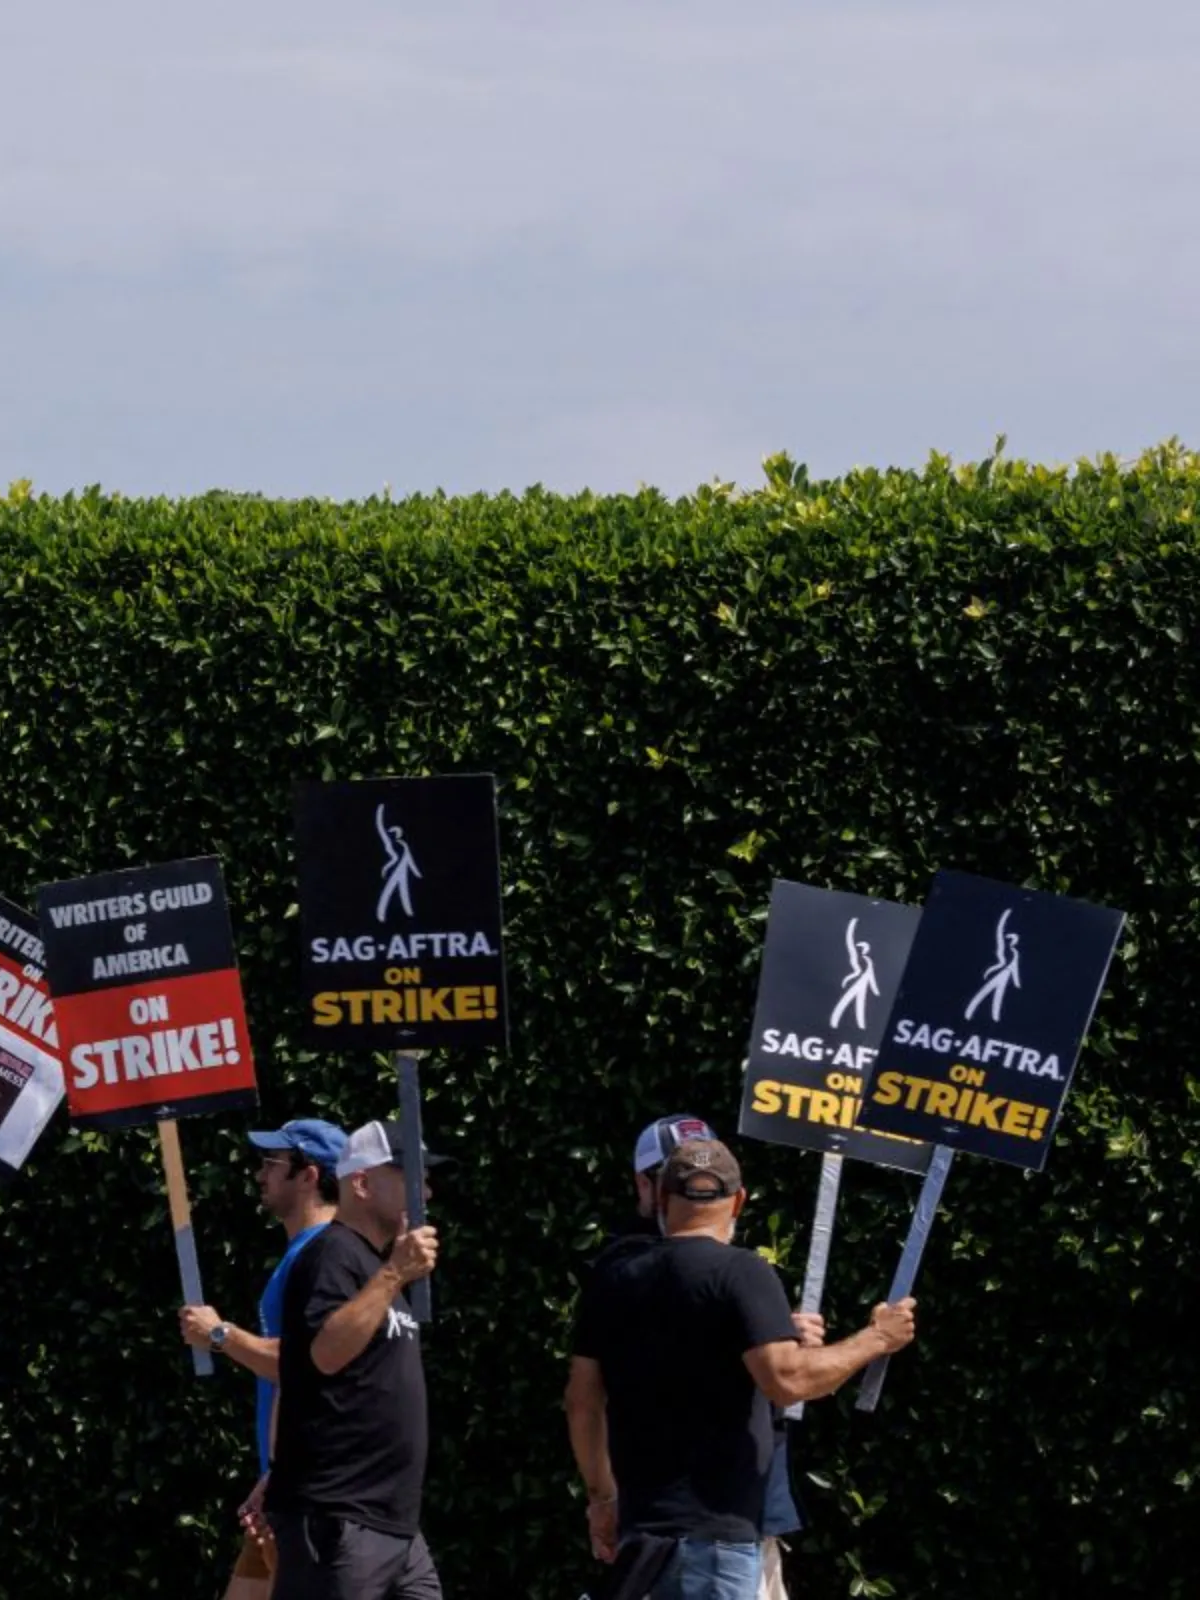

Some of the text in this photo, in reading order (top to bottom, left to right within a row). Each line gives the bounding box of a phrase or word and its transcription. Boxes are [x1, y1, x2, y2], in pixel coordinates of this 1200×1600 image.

[49, 882, 213, 928] WRITERS GUILD
[123, 923, 147, 943] OF
[92, 944, 189, 980] AMERICA
[384, 966, 421, 985] ON
[129, 995, 169, 1025] ON
[312, 985, 498, 1027] STRIKE!
[70, 1017, 241, 1089] STRIKE!
[826, 1072, 863, 1094] ON
[950, 1064, 986, 1087] ON
[873, 1071, 1050, 1141] STRIKE!
